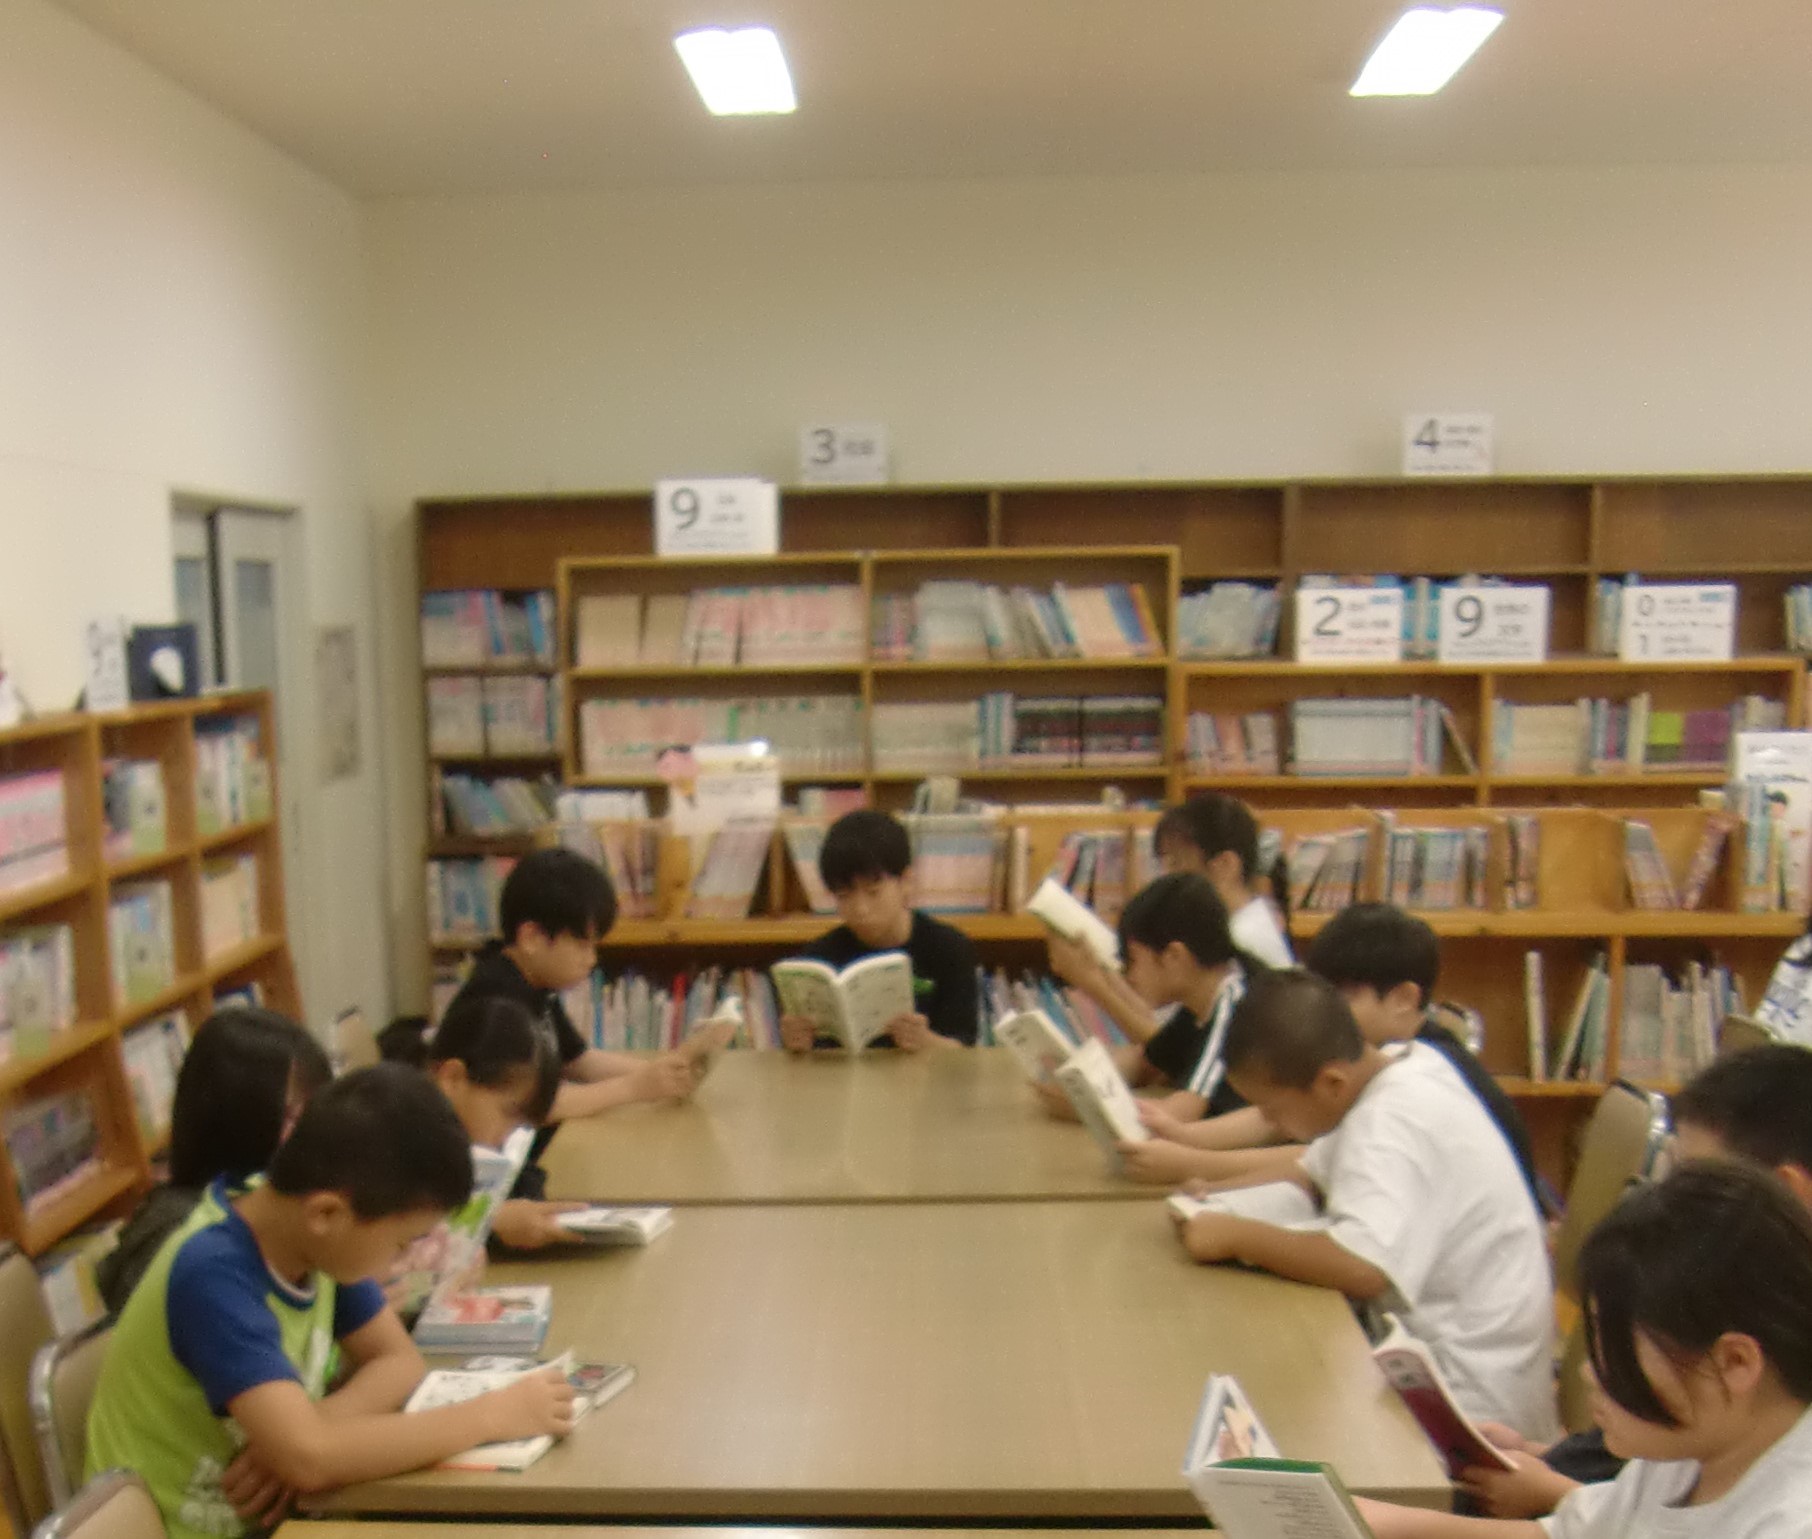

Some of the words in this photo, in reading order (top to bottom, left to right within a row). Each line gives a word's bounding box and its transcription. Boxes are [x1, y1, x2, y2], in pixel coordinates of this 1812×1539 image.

[811, 428, 835, 464] 3
[1412, 418, 1439, 454] 4
[670, 487, 699, 530] 9
[1314, 596, 1341, 636] 2
[1455, 595, 1483, 637] 9
